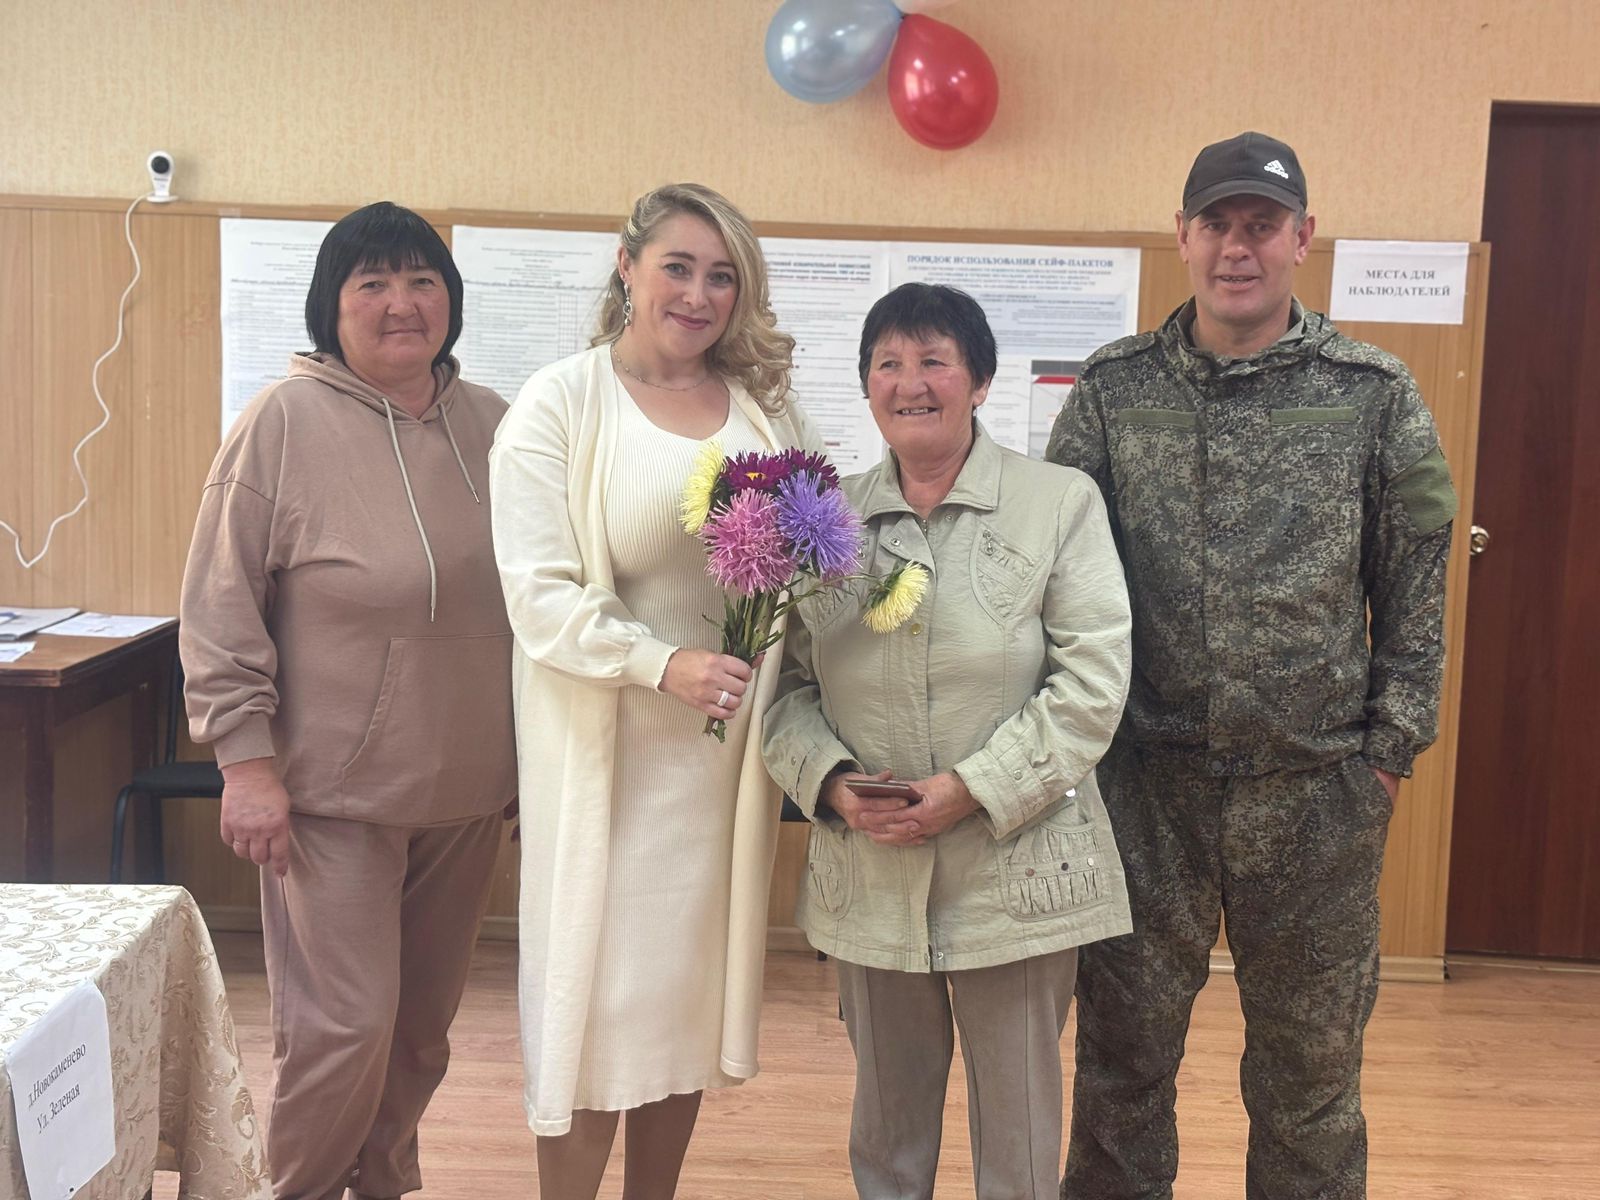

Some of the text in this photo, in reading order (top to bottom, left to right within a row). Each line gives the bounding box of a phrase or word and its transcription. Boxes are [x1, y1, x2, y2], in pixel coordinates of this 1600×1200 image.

[907, 255, 1114, 268] ПОРЯДОК ИСПОЛЬЗОВАНИЯ СЕЙФ-ПАКЕТОВ
[1366, 270, 1435, 280] МЕСТА ДЛЯ
[1348, 285, 1450, 296] НАБЛЮДАТЕЛЕЙ
[49, 1084, 80, 1119] Зеленая
